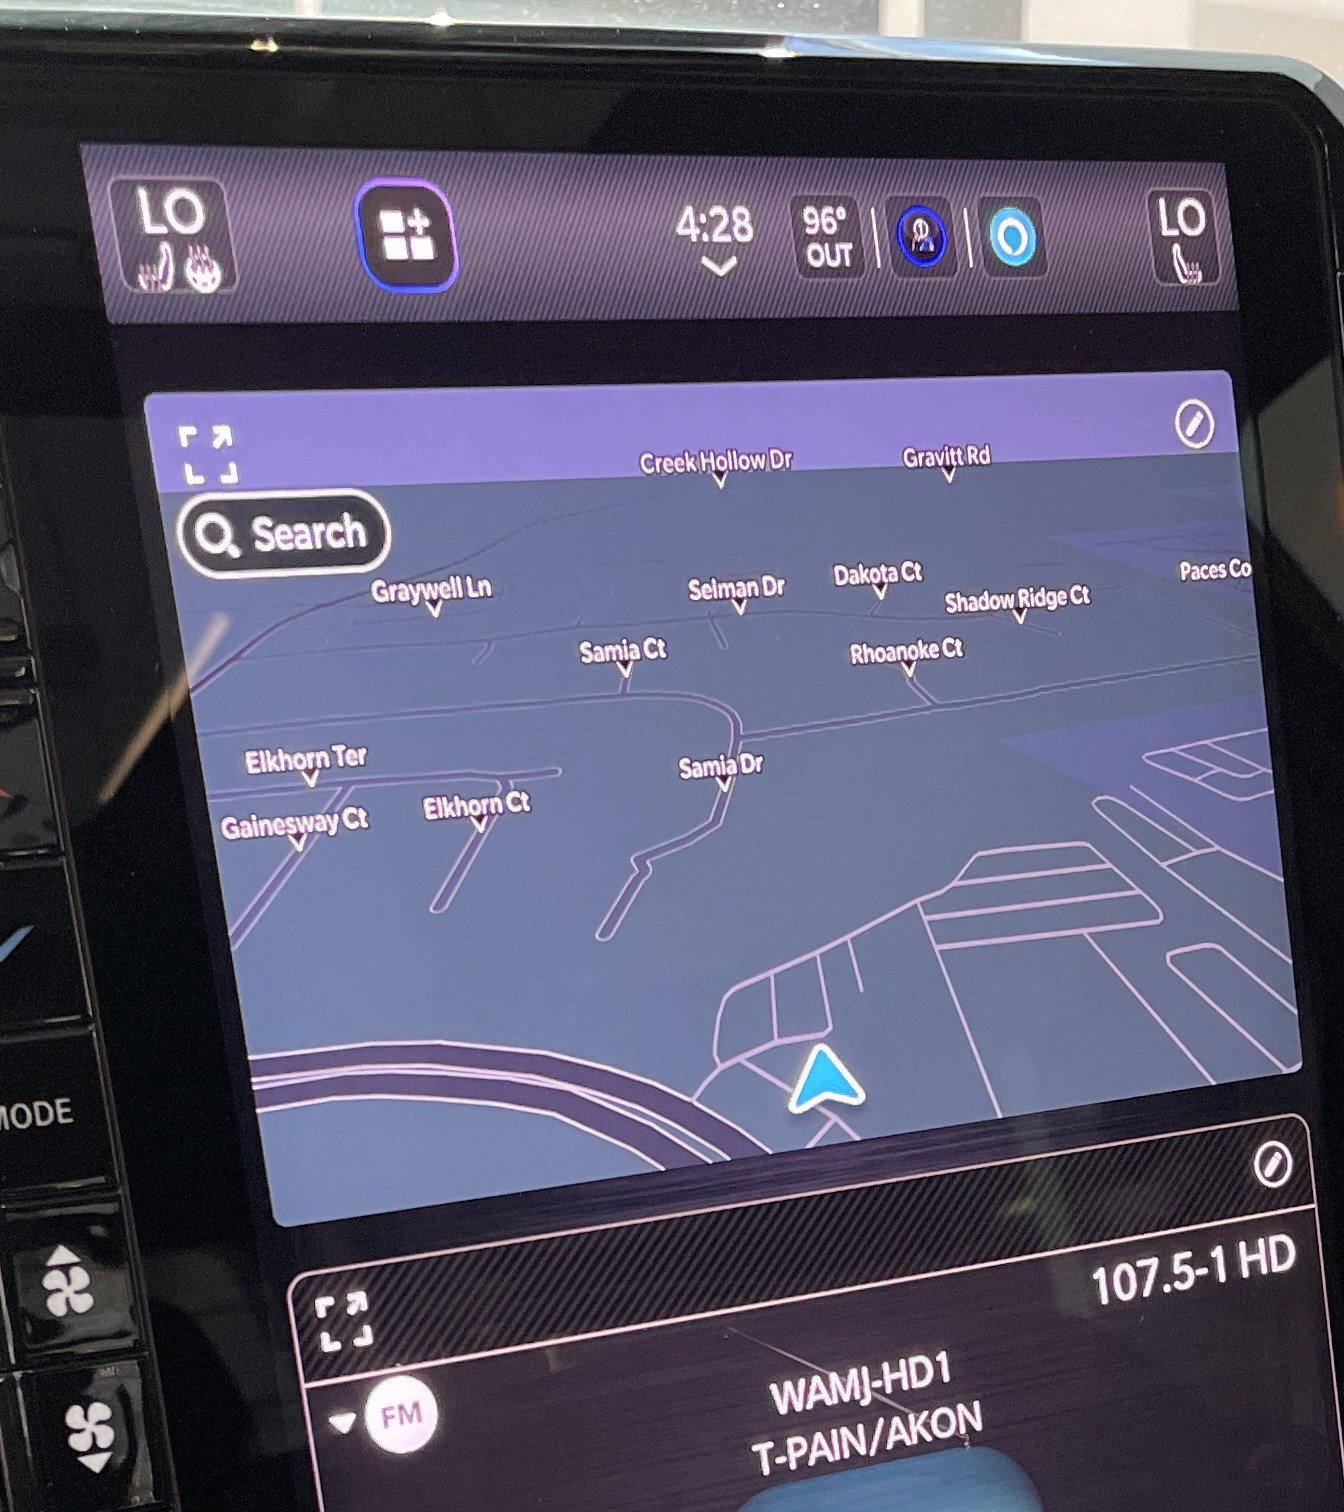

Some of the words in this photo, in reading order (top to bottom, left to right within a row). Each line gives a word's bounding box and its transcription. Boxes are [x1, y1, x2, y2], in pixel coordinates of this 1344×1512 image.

[137, 186, 206, 235] LO
[675, 205, 754, 243] 4:28
[802, 205, 847, 235] 96°
[1158, 197, 1207, 237] LO
[806, 242, 854, 268] OUT
[640, 452, 697, 475] Creek
[699, 449, 766, 472] Hollow
[770, 448, 794, 470] Dr
[902, 445, 964, 469] Gravitt
[967, 444, 992, 466] Rd
[251, 512, 367, 552] Search
[833, 564, 899, 587] Dakota
[901, 561, 924, 582] Ct
[1180, 561, 1227, 581] Paces
[1229, 557, 1253, 578] Co
[371, 577, 463, 606] Graywell
[466, 576, 493, 598] Ln
[688, 577, 757, 601] Selman
[761, 574, 786, 597] Dr
[945, 590, 1015, 614] Shadow
[1018, 587, 1067, 614] Ridge
[1070, 584, 1091, 605] Ct
[579, 639, 640, 664] Samia
[642, 637, 667, 661] Ct
[849, 639, 940, 666] Rhoanoke
[941, 636, 964, 658] Ct
[245, 749, 329, 776] Elkhorn
[332, 744, 368, 769] Ter
[679, 756, 737, 780] Samia
[739, 753, 764, 776] Dr
[423, 797, 504, 821] Elkhorn
[505, 792, 531, 814] Ct
[220, 810, 338, 841] Gainesway
[342, 807, 369, 831] Ct
[1093, 1245, 1226, 1305] 107.5-1
[1240, 1233, 1297, 1277] HD
[769, 1350, 952, 1416] WAMJ-HD1
[381, 1400, 422, 1430] FM
[752, 1400, 984, 1477] T-PAIN/AKON
